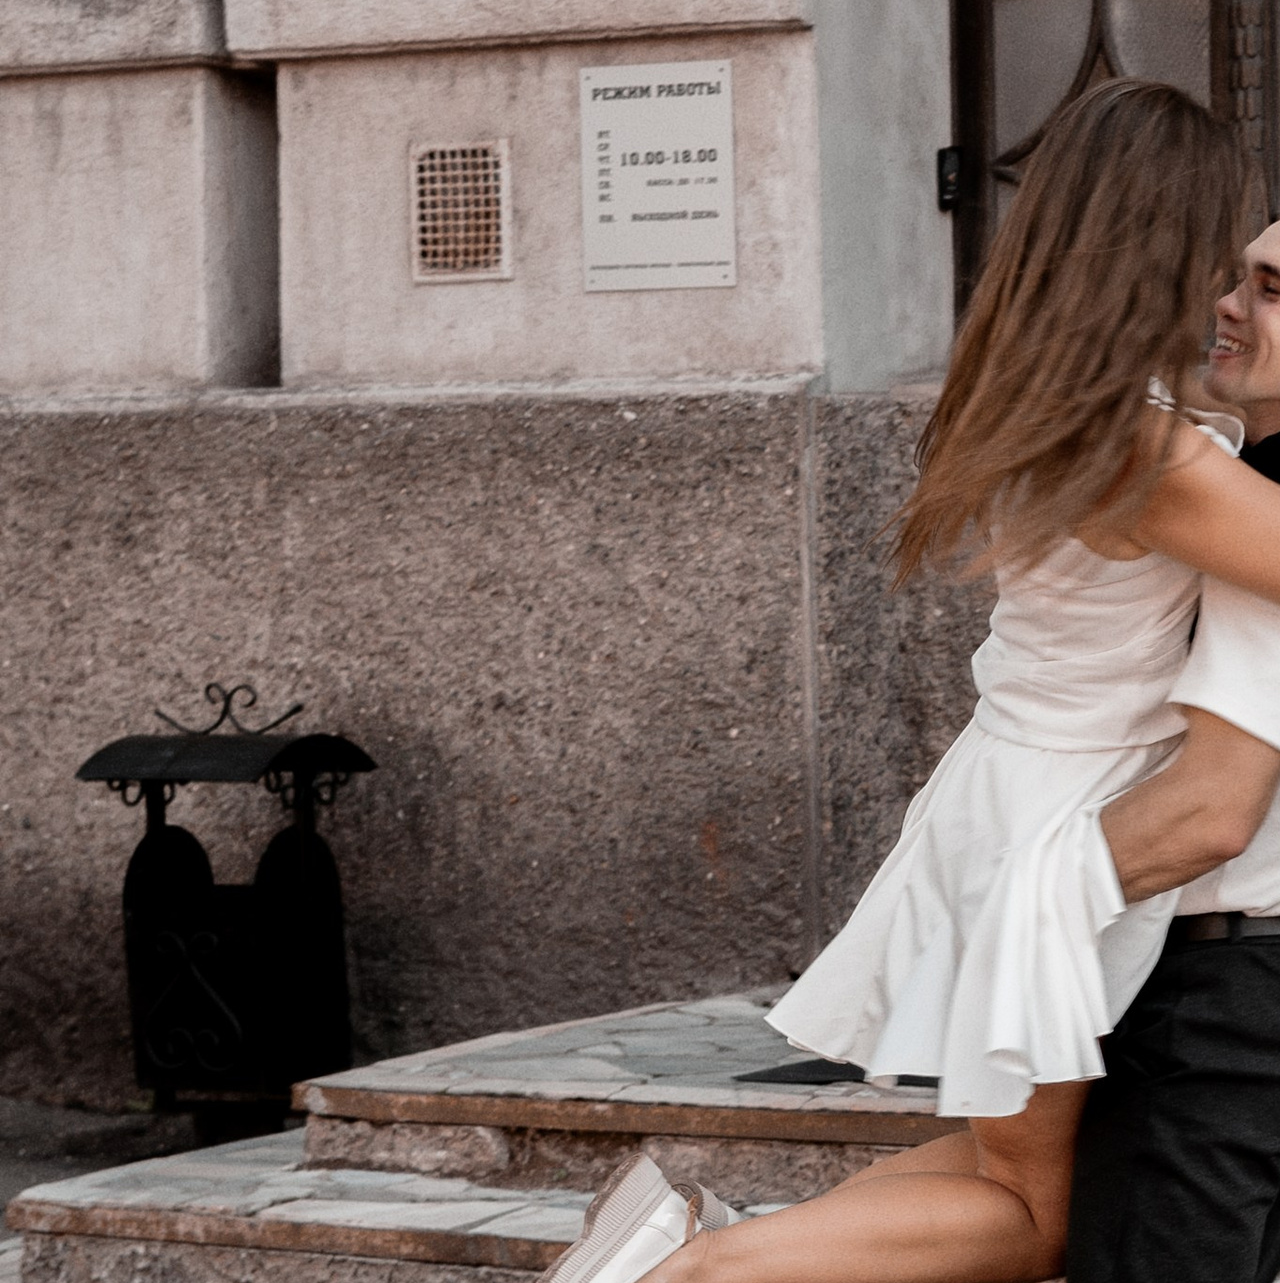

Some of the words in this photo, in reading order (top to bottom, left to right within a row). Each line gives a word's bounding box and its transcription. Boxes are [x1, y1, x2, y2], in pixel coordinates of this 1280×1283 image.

[592, 85, 651, 101] РЕЖИМ
[656, 81, 722, 98] РАБОТЫ
[620, 149, 718, 167] 10.00-18.00
